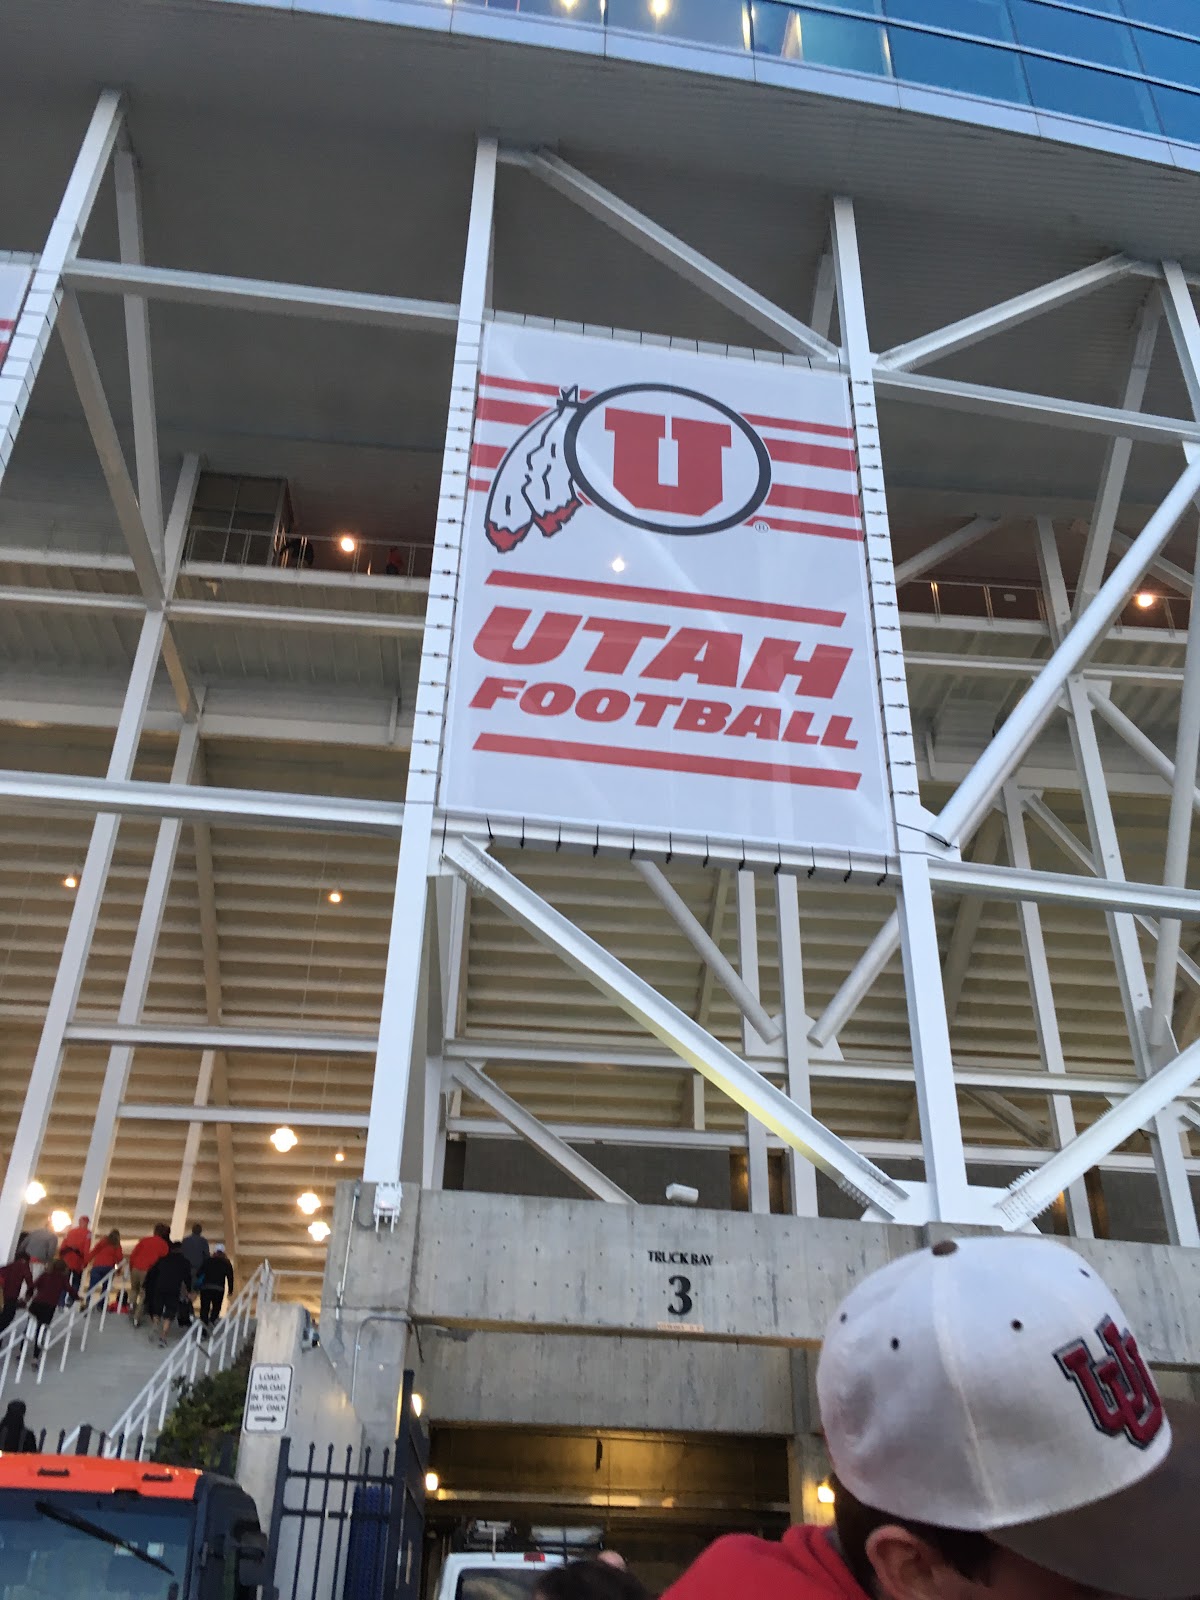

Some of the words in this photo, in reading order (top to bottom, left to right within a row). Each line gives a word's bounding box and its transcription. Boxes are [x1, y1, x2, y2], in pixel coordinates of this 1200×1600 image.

[605, 407, 732, 517] U
[473, 605, 853, 699] UTAH
[469, 676, 858, 749] FOOTBALL
[647, 1250, 689, 1265] TRUCK
[691, 1253, 713, 1266] BAY
[667, 1274, 693, 1316] 3
[251, 1393, 259, 1401] IN
[262, 1393, 286, 1402] TRUCK
[254, 1383, 286, 1391] UNLOAD
[249, 1403, 262, 1412] BAY
[266, 1403, 285, 1412] ONLY
